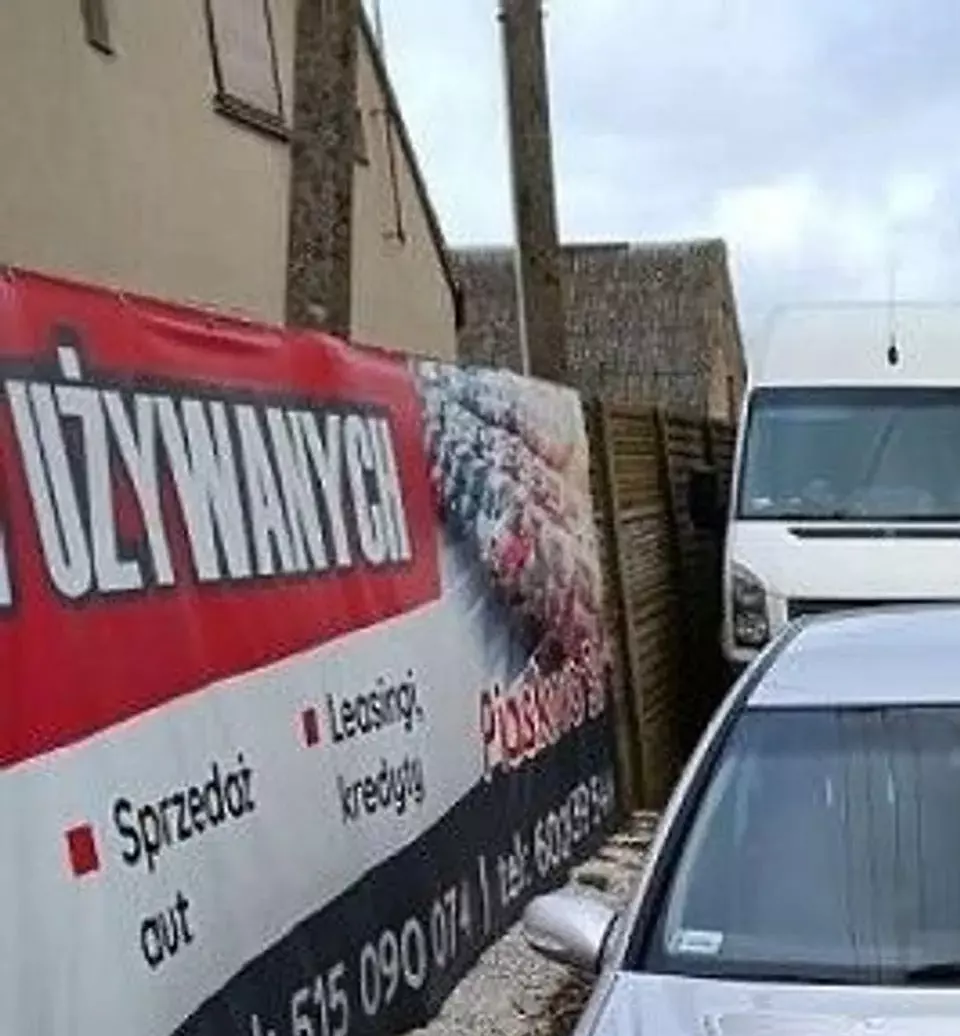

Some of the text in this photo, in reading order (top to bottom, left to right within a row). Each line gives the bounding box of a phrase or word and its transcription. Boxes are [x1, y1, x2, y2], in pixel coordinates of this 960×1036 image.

[4, 345, 413, 600] UŻYWANYCH
[113, 752, 256, 873] Sprzedaż
[336, 755, 425, 826] kredyty
[140, 889, 195, 969] aut
[360, 915, 427, 1016] 090
